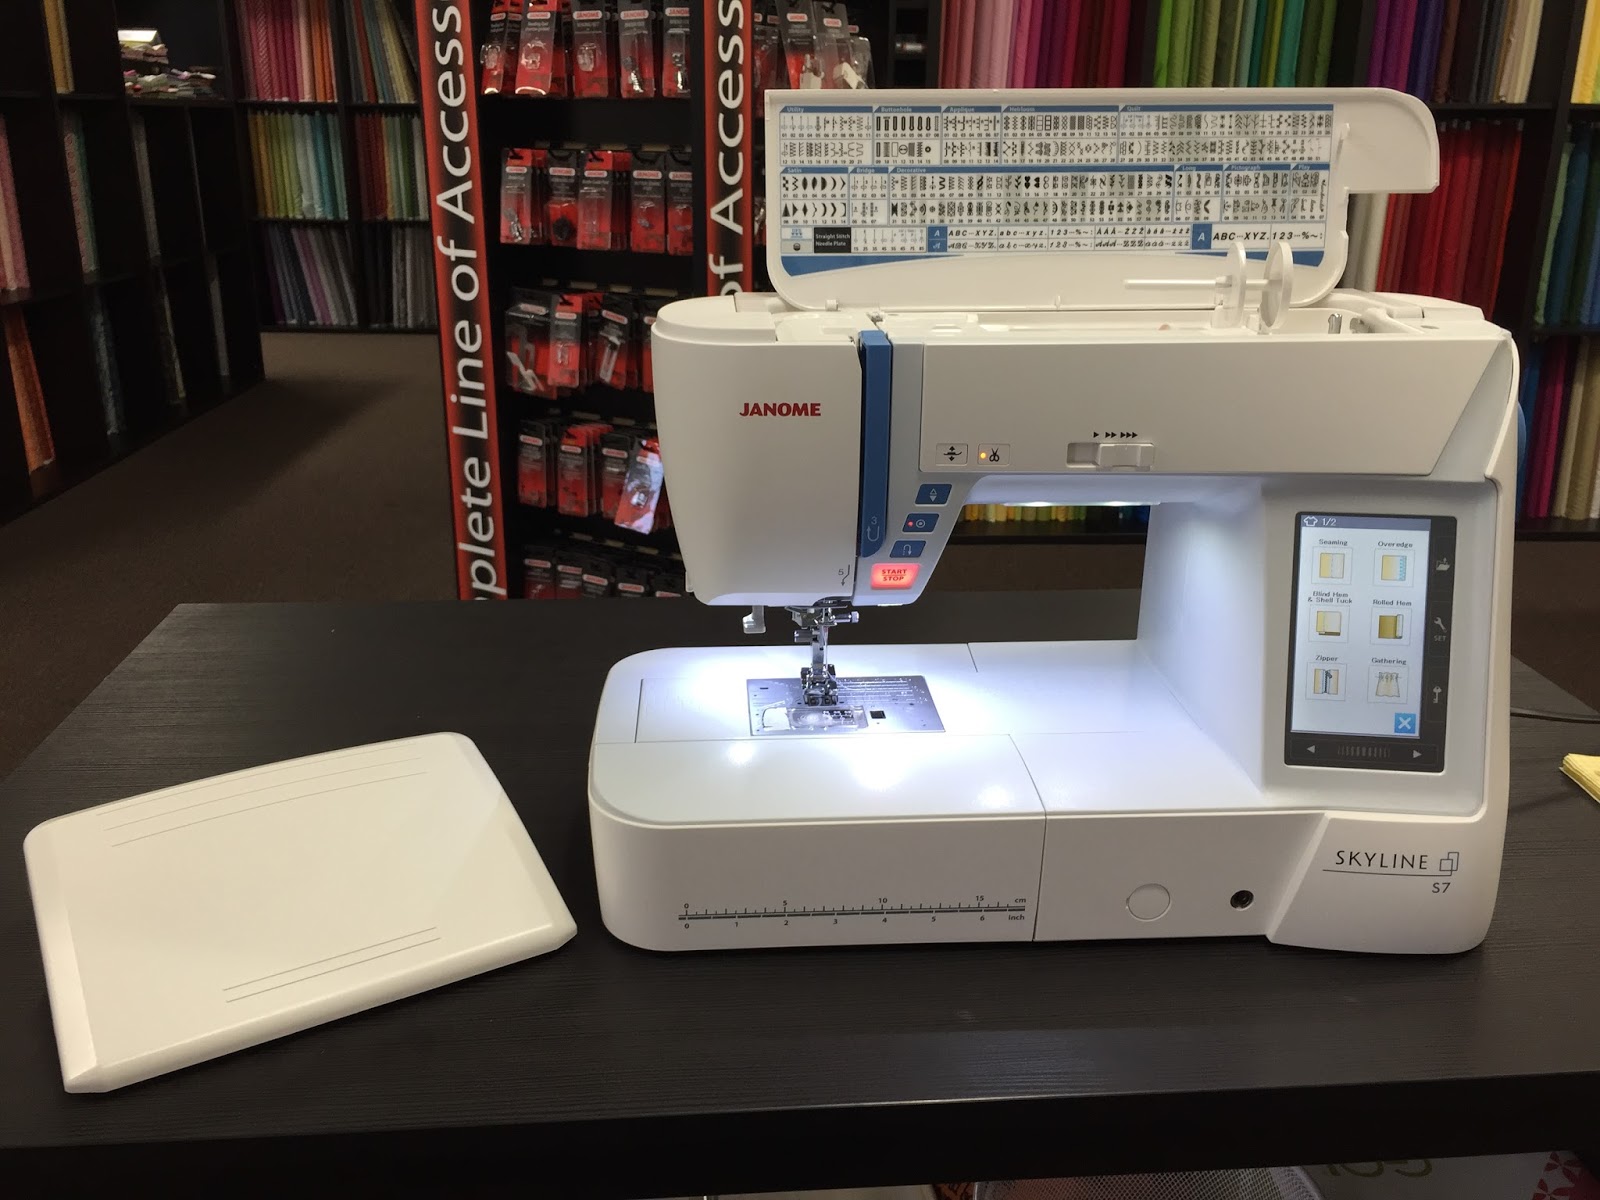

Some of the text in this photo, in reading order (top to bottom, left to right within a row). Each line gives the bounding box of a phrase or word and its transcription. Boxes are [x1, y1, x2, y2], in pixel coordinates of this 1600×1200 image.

[709, 0, 744, 236] Access
[1197, 232, 1205, 241] A
[431, 5, 508, 600] plete Line of Access
[739, 402, 821, 417] JANOME
[871, 516, 877, 525] 3
[1322, 518, 1336, 526] 1/2
[1336, 850, 1429, 870] SKYLINE
[1432, 882, 1451, 894] S7
